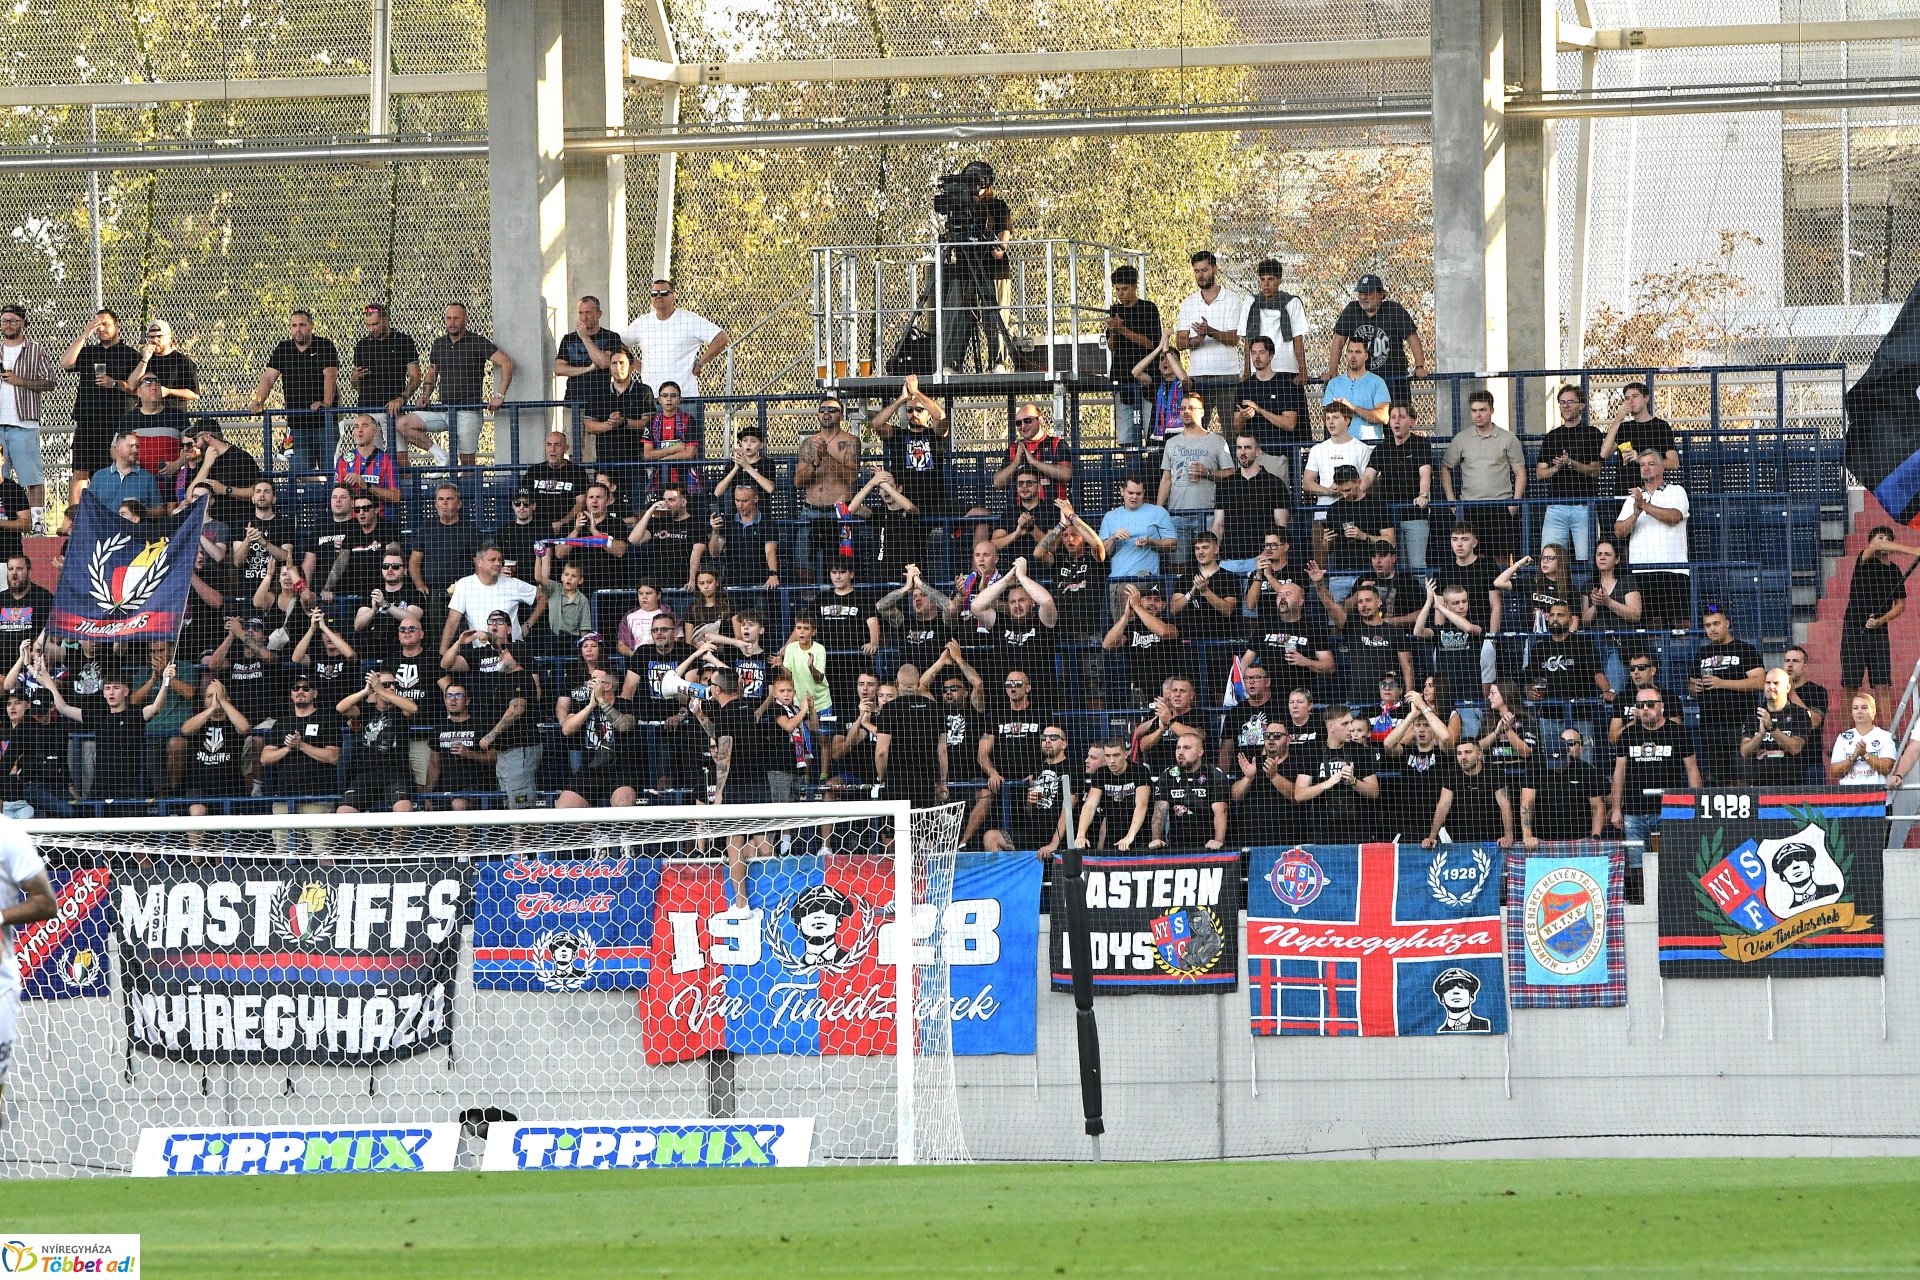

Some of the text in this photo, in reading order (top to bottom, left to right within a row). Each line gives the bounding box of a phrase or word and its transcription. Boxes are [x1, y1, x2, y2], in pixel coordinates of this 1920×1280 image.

[1701, 795, 1750, 819] 1928
[504, 858, 628, 883] Special
[1286, 866, 1306, 878] NY S
[1442, 867, 1477, 881] 1928
[1708, 850, 1763, 906] NY S
[1082, 867, 1223, 908] ASTERN
[515, 892, 615, 919] Guests
[1744, 900, 1764, 930] F
[1154, 917, 1184, 941] NY S
[1259, 925, 1493, 955] Nyíregyháza
[1166, 945, 1175, 962] F
[1744, 938, 1775, 956] Vén
[132, 983, 446, 1054] NYÍREGYHÁZA
[768, 981, 1001, 1030] Tinédzerek
